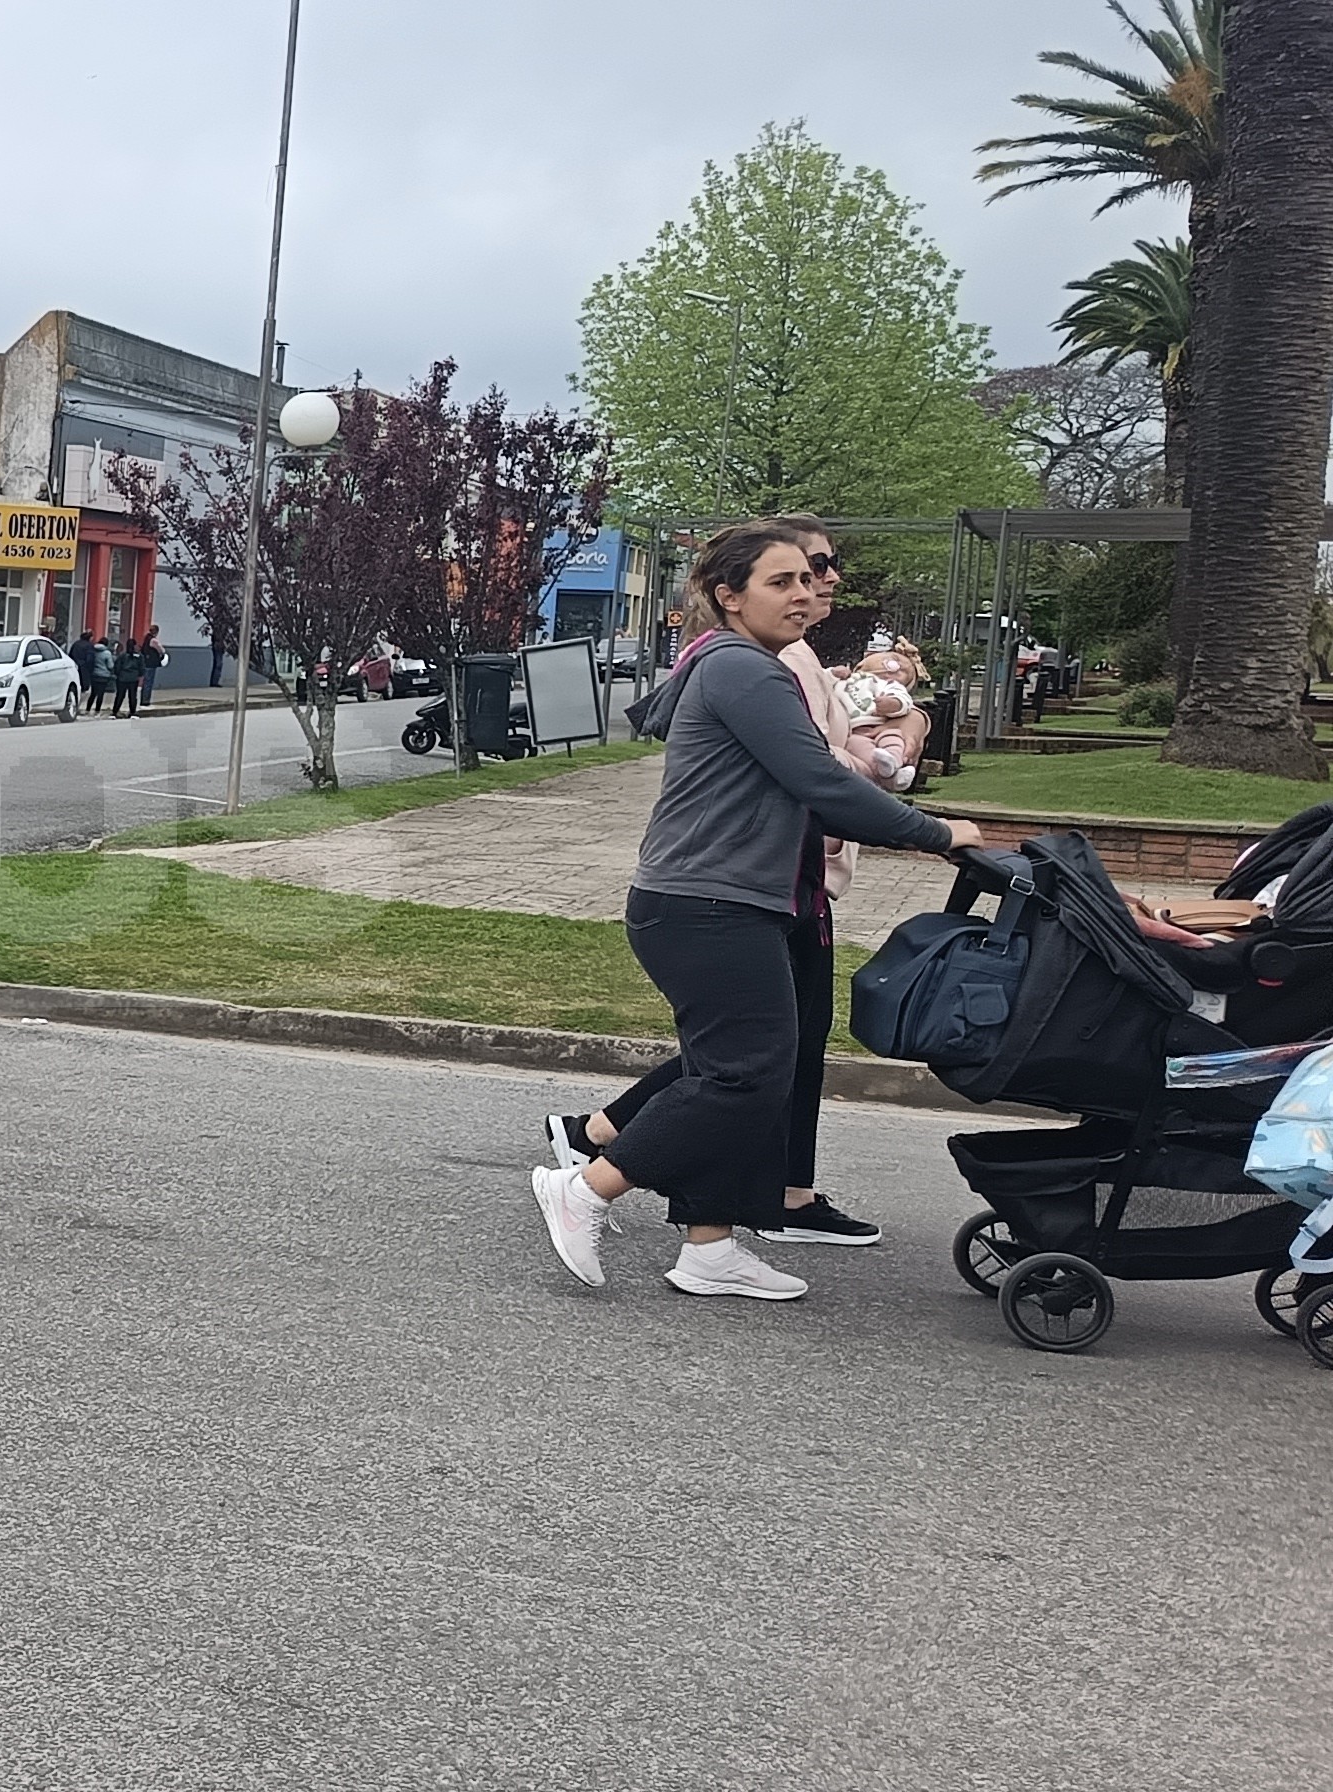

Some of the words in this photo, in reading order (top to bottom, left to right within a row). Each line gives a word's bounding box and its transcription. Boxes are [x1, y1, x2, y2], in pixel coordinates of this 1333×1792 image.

[8, 513, 78, 541] OFERTON
[2, 544, 35, 558] 4536
[40, 546, 72, 559] 7023
